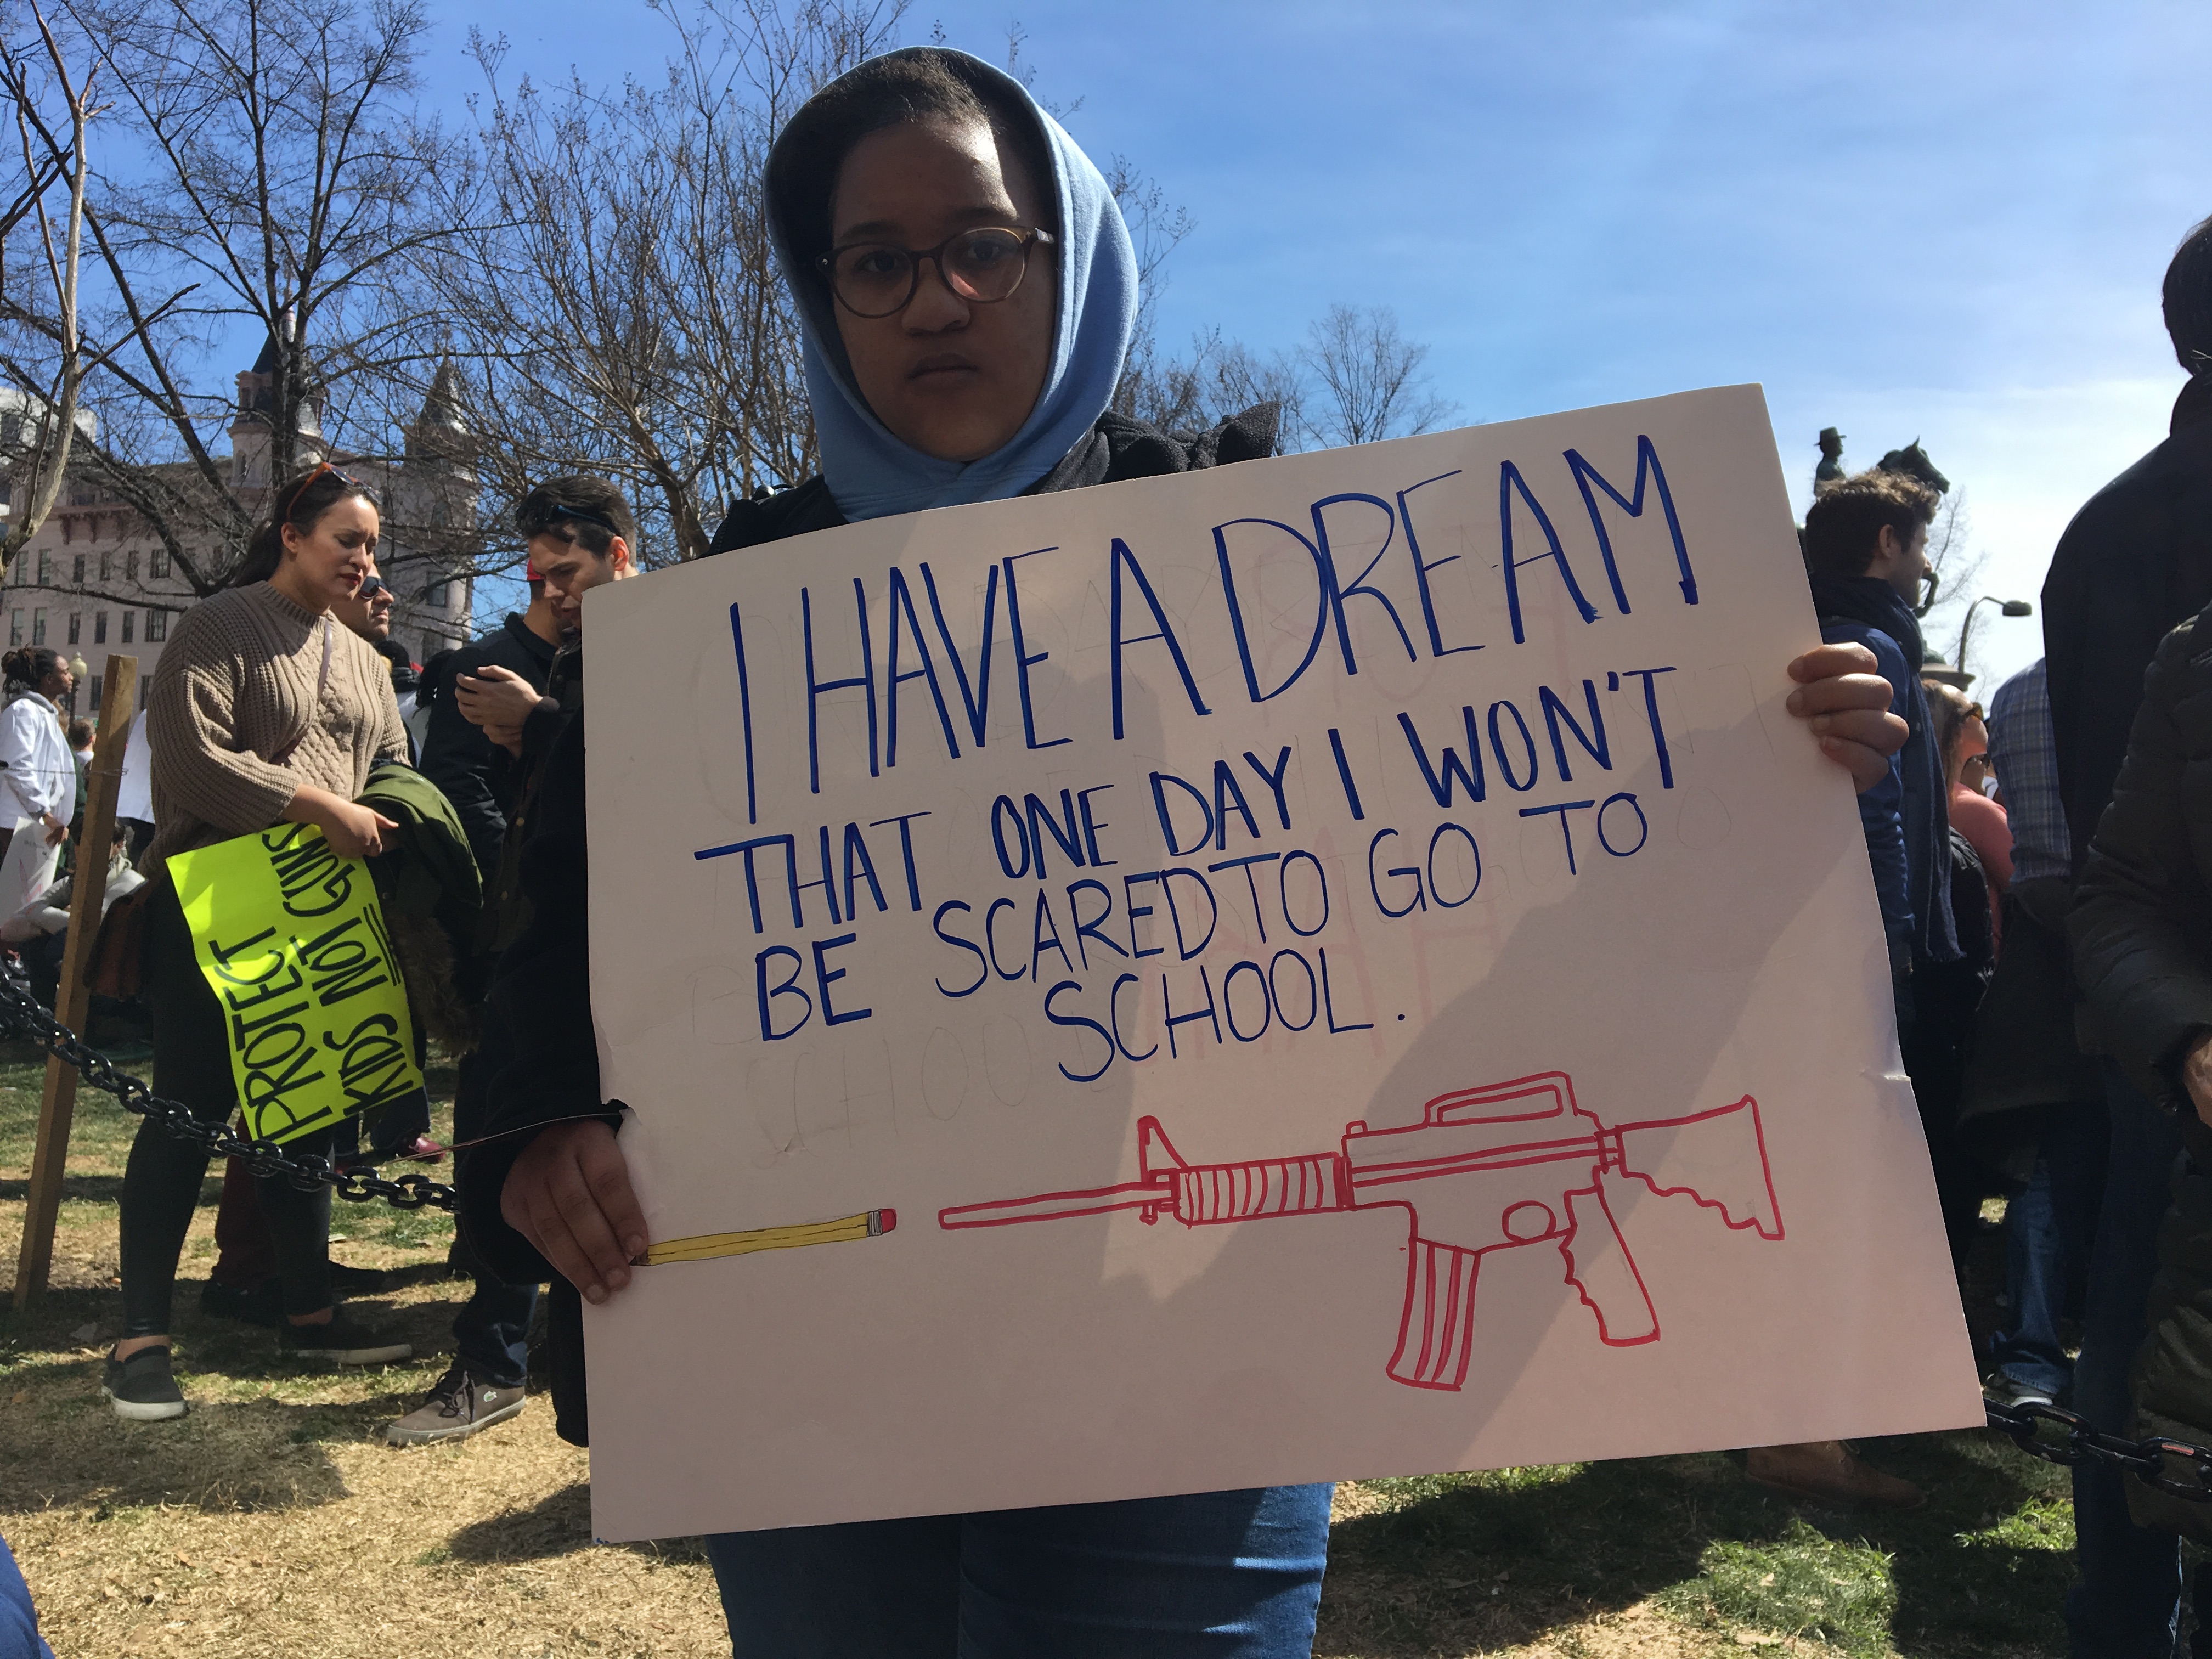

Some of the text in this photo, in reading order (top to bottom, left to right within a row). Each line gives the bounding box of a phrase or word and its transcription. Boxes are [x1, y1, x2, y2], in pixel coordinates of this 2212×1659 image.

[729, 435, 1699, 825] I HAVE A DREAM
[694, 665, 1677, 933] THAT ONE DAY I WON'T
[754, 792, 1649, 1041] BE SCARED TO GO TO
[208, 927, 332, 1142] PROTECT
[262, 822, 414, 1117] KIDS NOT GUNS
[1044, 947, 1407, 1082] SCHOOL.
